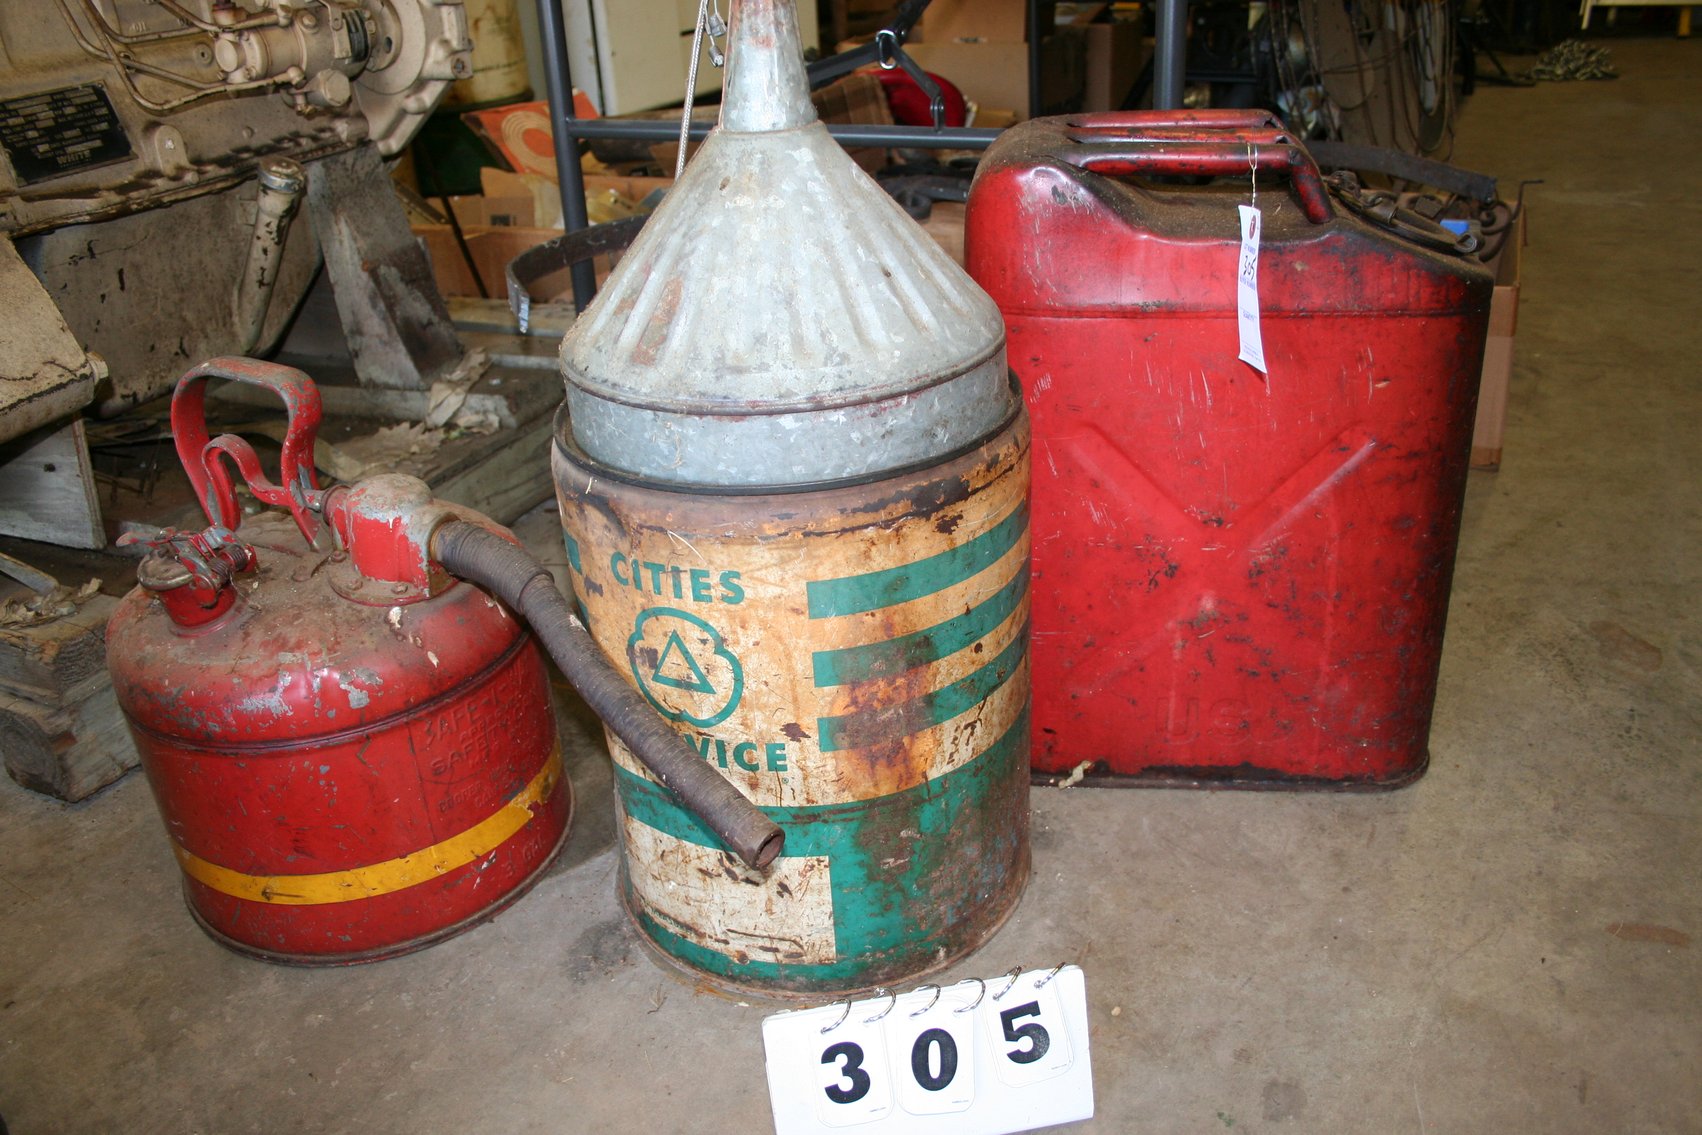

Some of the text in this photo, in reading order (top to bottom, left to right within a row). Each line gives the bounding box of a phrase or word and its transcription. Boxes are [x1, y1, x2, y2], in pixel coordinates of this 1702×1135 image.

[610, 551, 745, 605] CITIES
[683, 733, 788, 773] VICE
[820, 1000, 1051, 1105] 305
